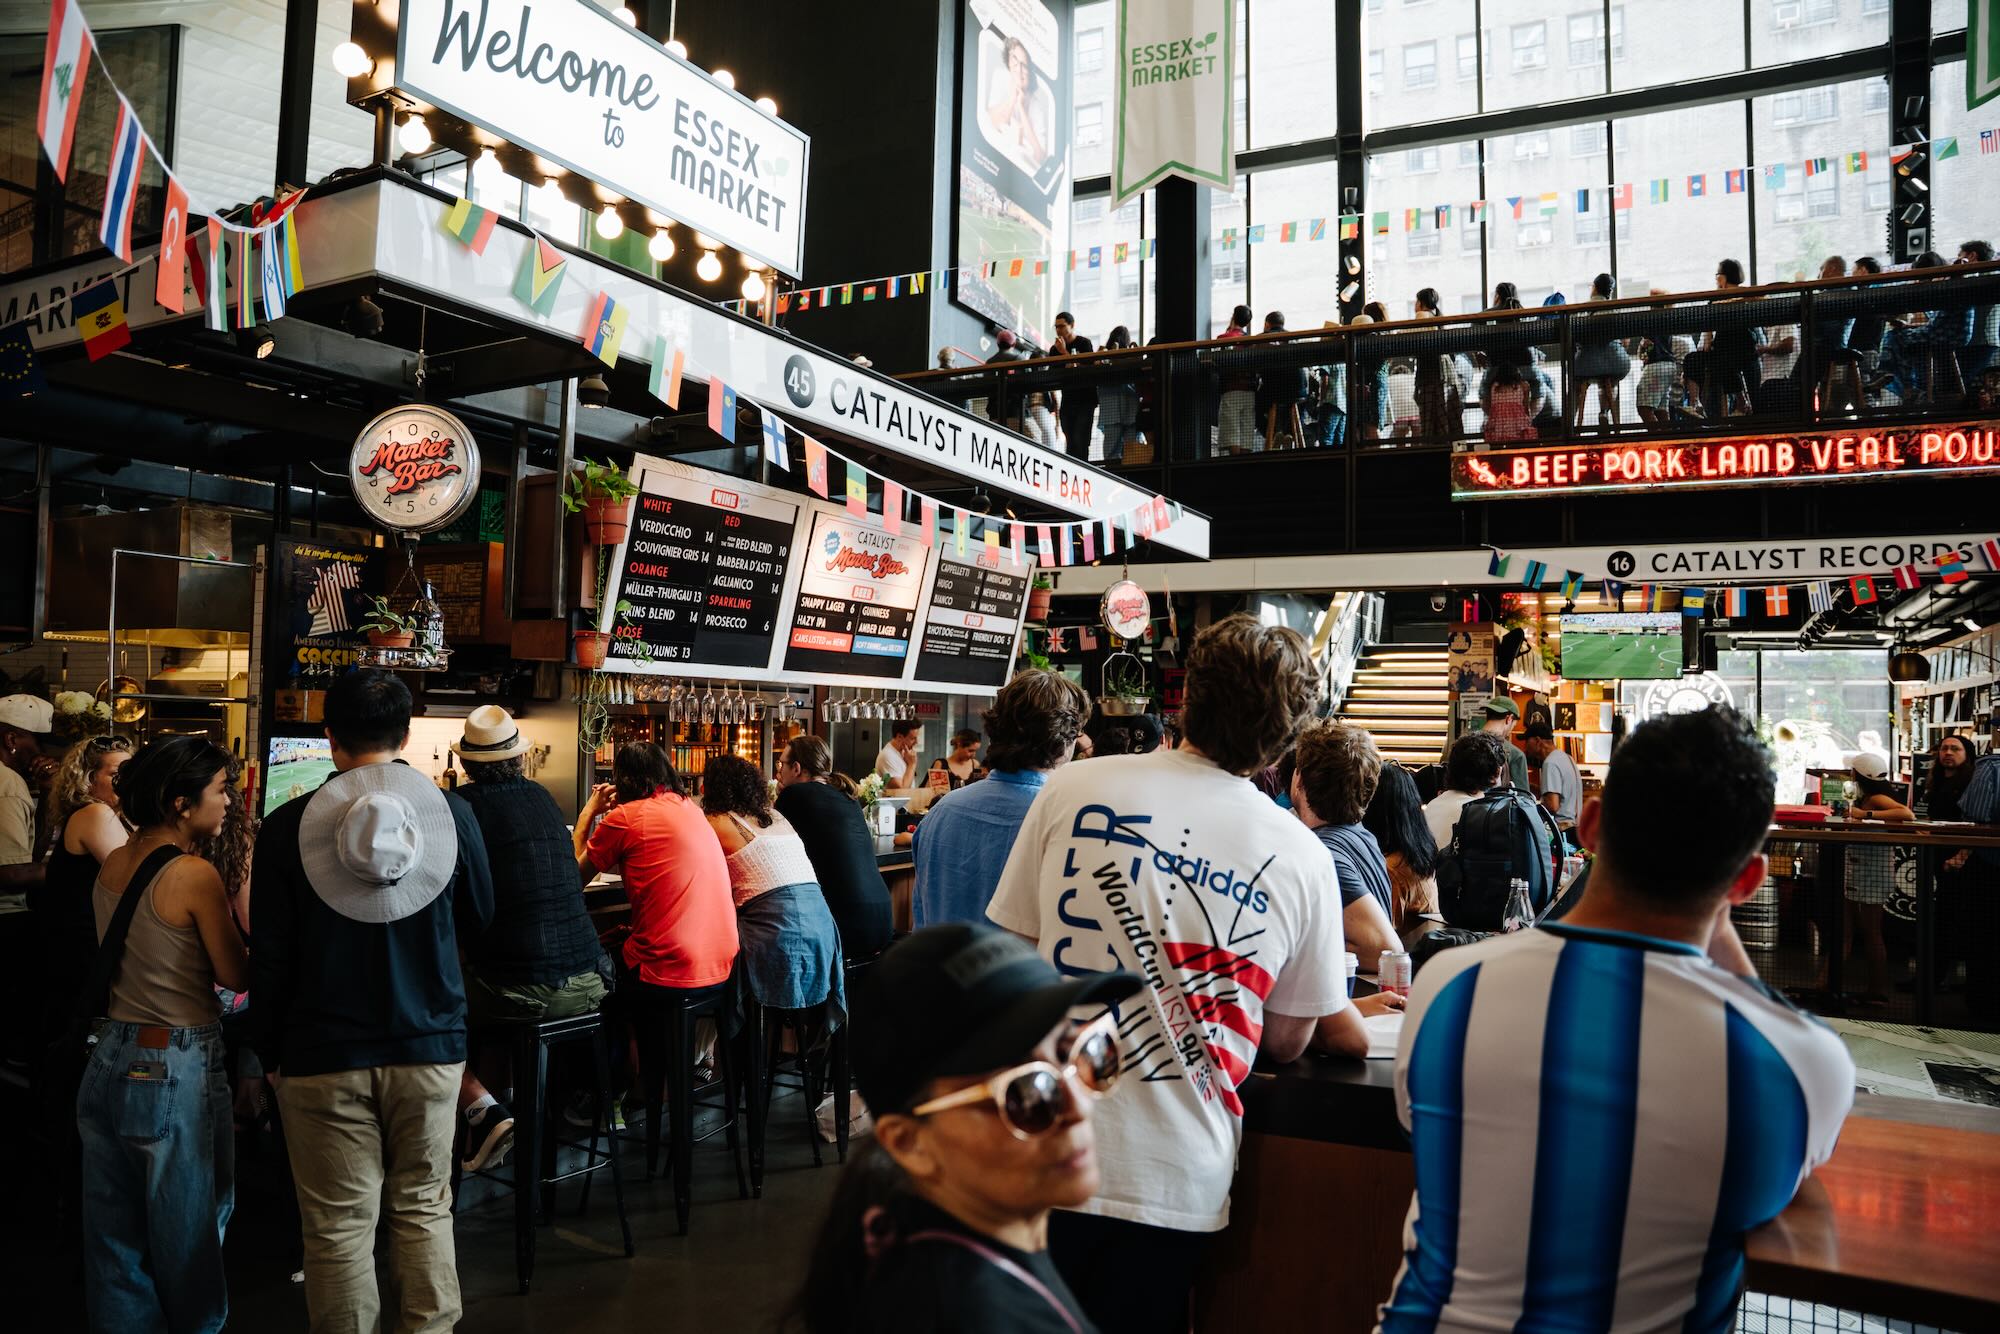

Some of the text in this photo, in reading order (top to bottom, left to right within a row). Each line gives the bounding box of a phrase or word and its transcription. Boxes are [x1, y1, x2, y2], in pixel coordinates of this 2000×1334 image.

[432, 0, 660, 111] Welcome
[1132, 37, 1192, 65] ESSEX
[1132, 56, 1216, 87] MARKET
[602, 108, 625, 149] to
[674, 98, 760, 178] ESSEX
[670, 144, 787, 232] MARKET
[408, 423, 418, 436] 0
[787, 368, 1092, 507] 45 CATALYST MARKET BAR
[359, 437, 455, 476] Market
[1512, 453, 1588, 484] BEEF
[1603, 447, 1686, 480] PORK
[1700, 441, 1795, 476] LAMB
[1811, 436, 1904, 470] VEAL
[387, 461, 462, 496] Bar
[383, 494, 393, 507] 4
[406, 501, 415, 513] 5
[643, 496, 672, 514] WHITE
[714, 490, 737, 508] WINE
[725, 514, 741, 528] RED
[640, 519, 714, 544] VERDICCHIO 14
[735, 537, 787, 557] RED BLEND 10
[857, 531, 895, 551] CATALYST
[634, 540, 709, 563] SOUVIGNIER GRIS 14
[1611, 542, 1974, 573] 16 CATALYST RECORDS
[629, 562, 668, 578] ORANGE
[716, 555, 783, 576] BARBERA D'ASTI 13
[825, 545, 909, 579] Market Bar
[940, 562, 971, 577] CAPPELLETTI
[712, 574, 779, 594] AGLIANICO 14
[937, 579, 980, 595] HUGO 12
[986, 573, 1012, 586] AMERICANO
[625, 581, 702, 603] MÜLLER-THURGAU 13
[933, 594, 954, 606] BIANCO
[709, 595, 752, 610] SPARKLING
[801, 596, 855, 614] SNAPPY LAGER 6
[649, 606, 676, 621] BLEND
[689, 611, 698, 623] 14
[862, 605, 913, 622] GUINNESS 10
[616, 625, 643, 639] ROSÉ
[705, 614, 770, 632] PROSECCO 6
[796, 614, 852, 632] HAZY IPA 8
[858, 622, 908, 638] AMBER LAGER 8
[794, 633, 810, 643] CANS
[972, 631, 993, 643] FRIENDLY
[993, 634, 1005, 645] DOG
[646, 644, 678, 658] D'AUNIS
[682, 647, 691, 659] 13
[1153, 850, 1270, 914] adidas
